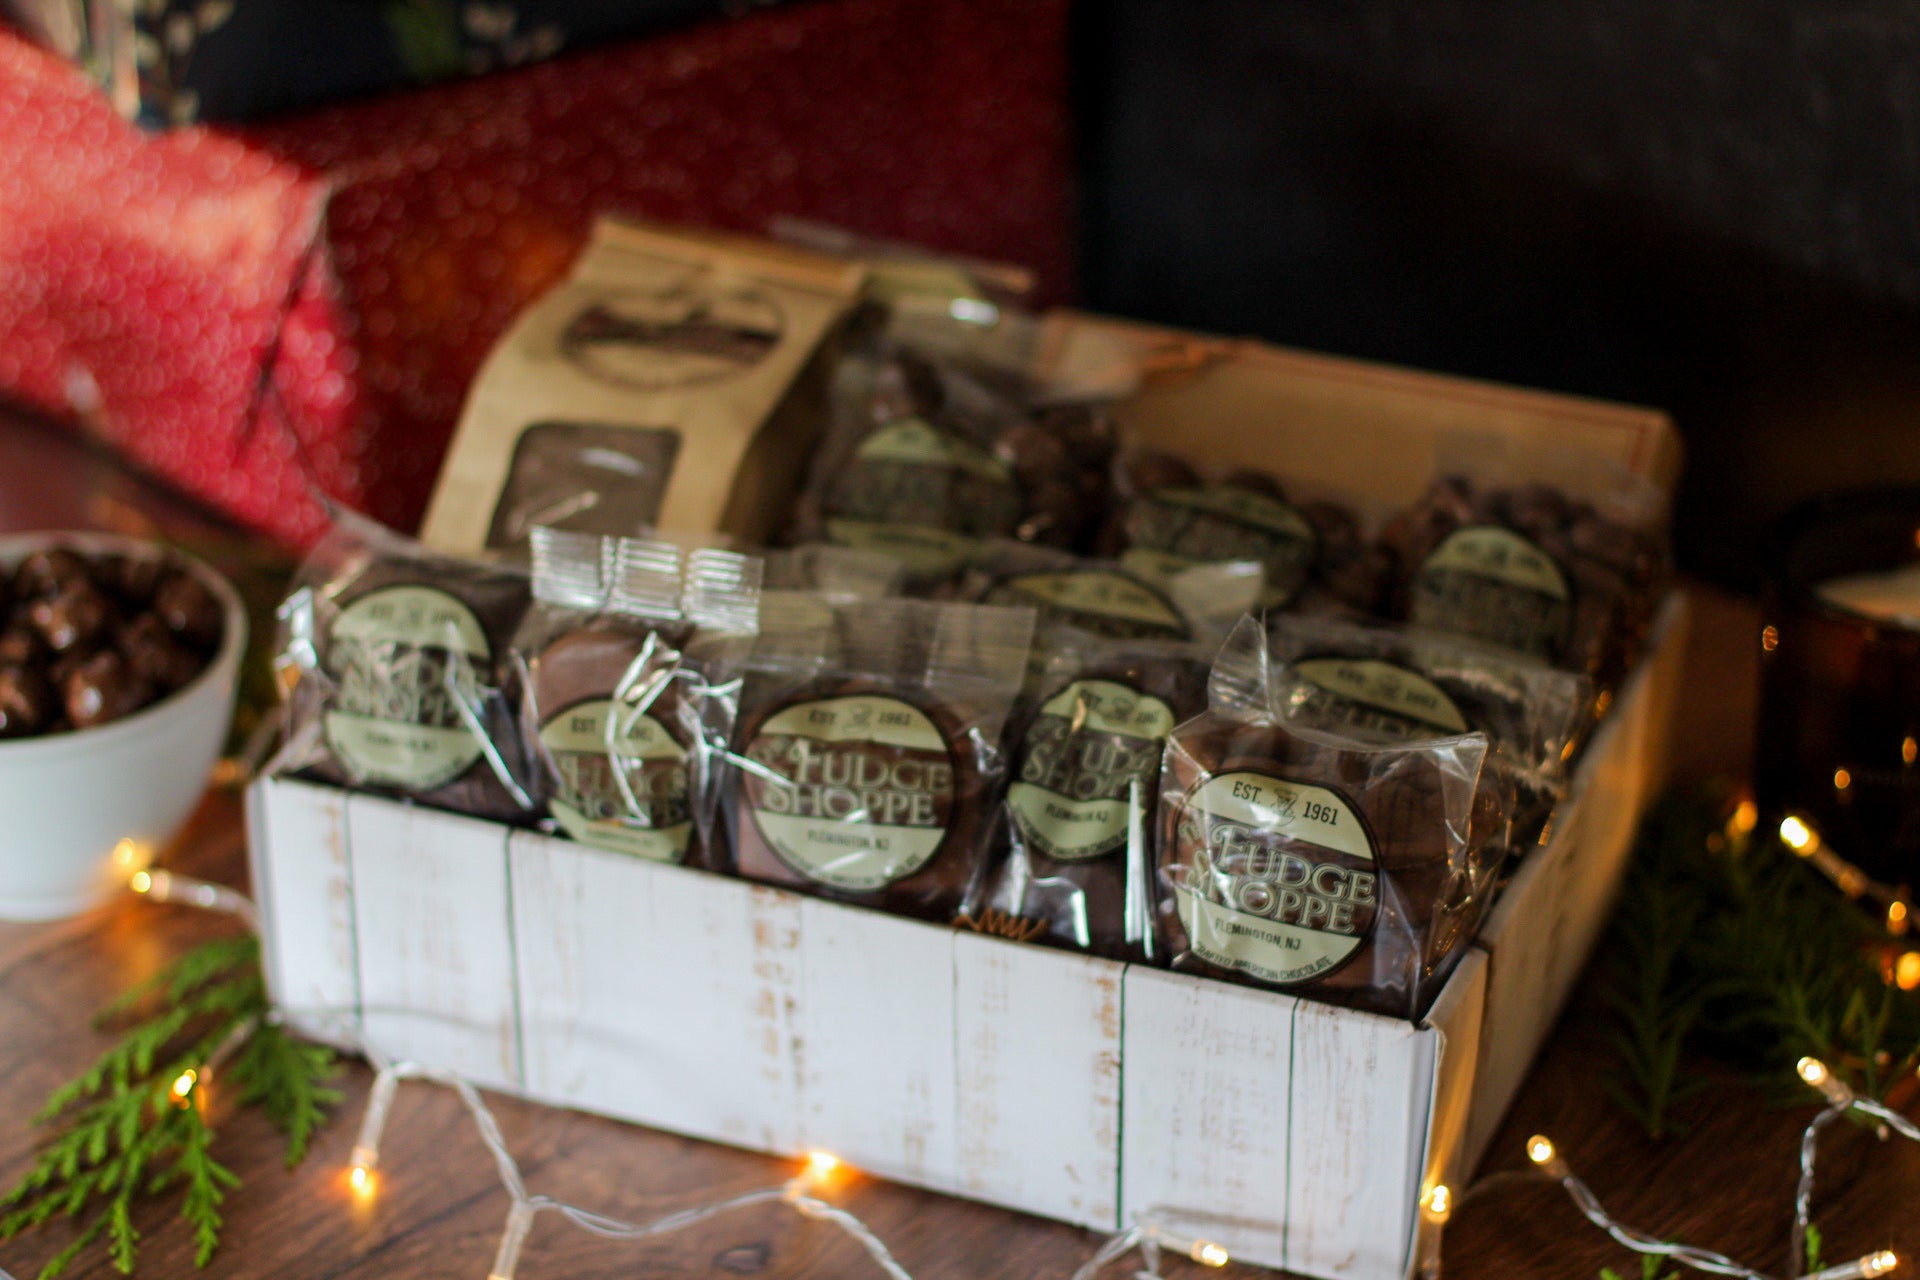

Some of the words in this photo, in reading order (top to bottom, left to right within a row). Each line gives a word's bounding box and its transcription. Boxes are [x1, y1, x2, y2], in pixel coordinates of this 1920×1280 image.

[1302, 801, 1338, 826] 1961
[1185, 848, 1356, 933] SHOPPE
[1210, 823, 1376, 905] FUDGE
[1284, 936, 1301, 951] NJ
